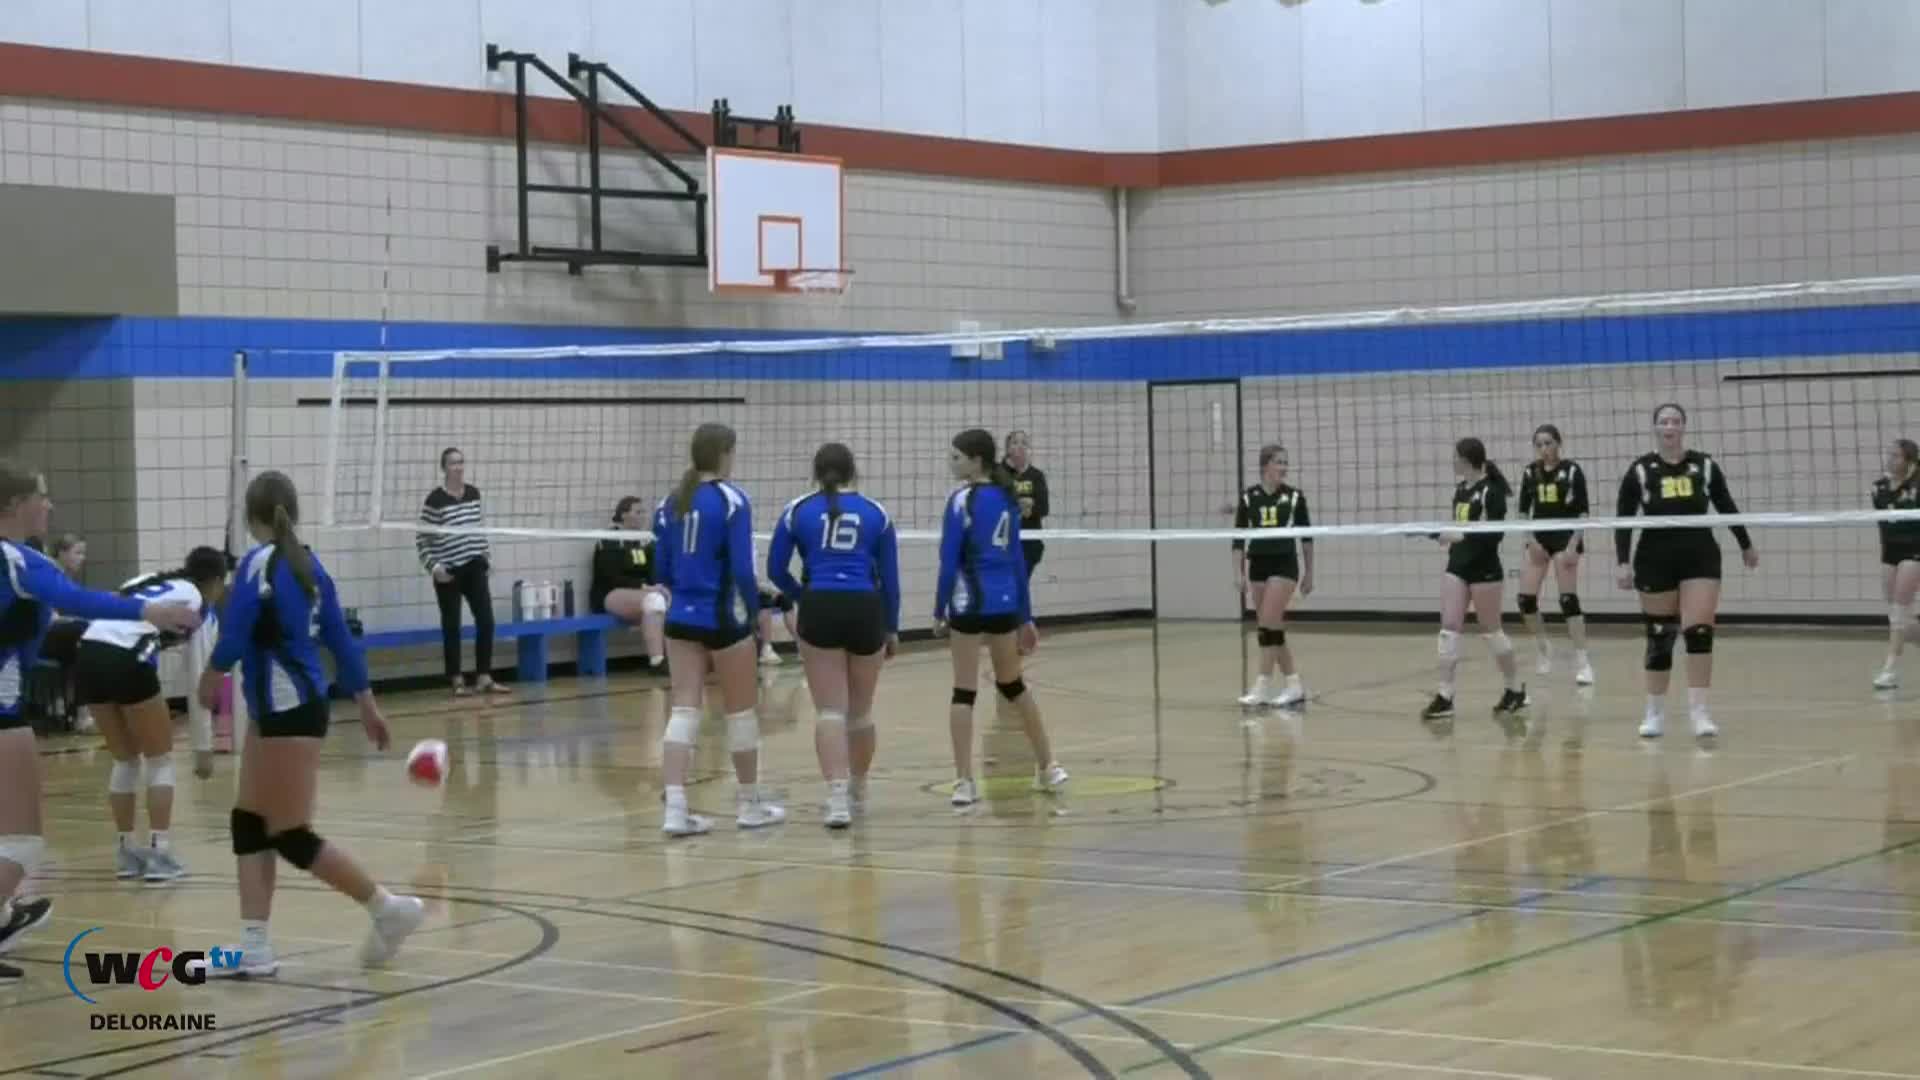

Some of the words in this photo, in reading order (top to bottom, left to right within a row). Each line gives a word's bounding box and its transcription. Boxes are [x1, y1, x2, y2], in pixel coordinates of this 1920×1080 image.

[1661, 477, 1693, 498] 20
[682, 509, 699, 553] 11
[820, 512, 860, 550] 16
[992, 510, 1010, 550] 4
